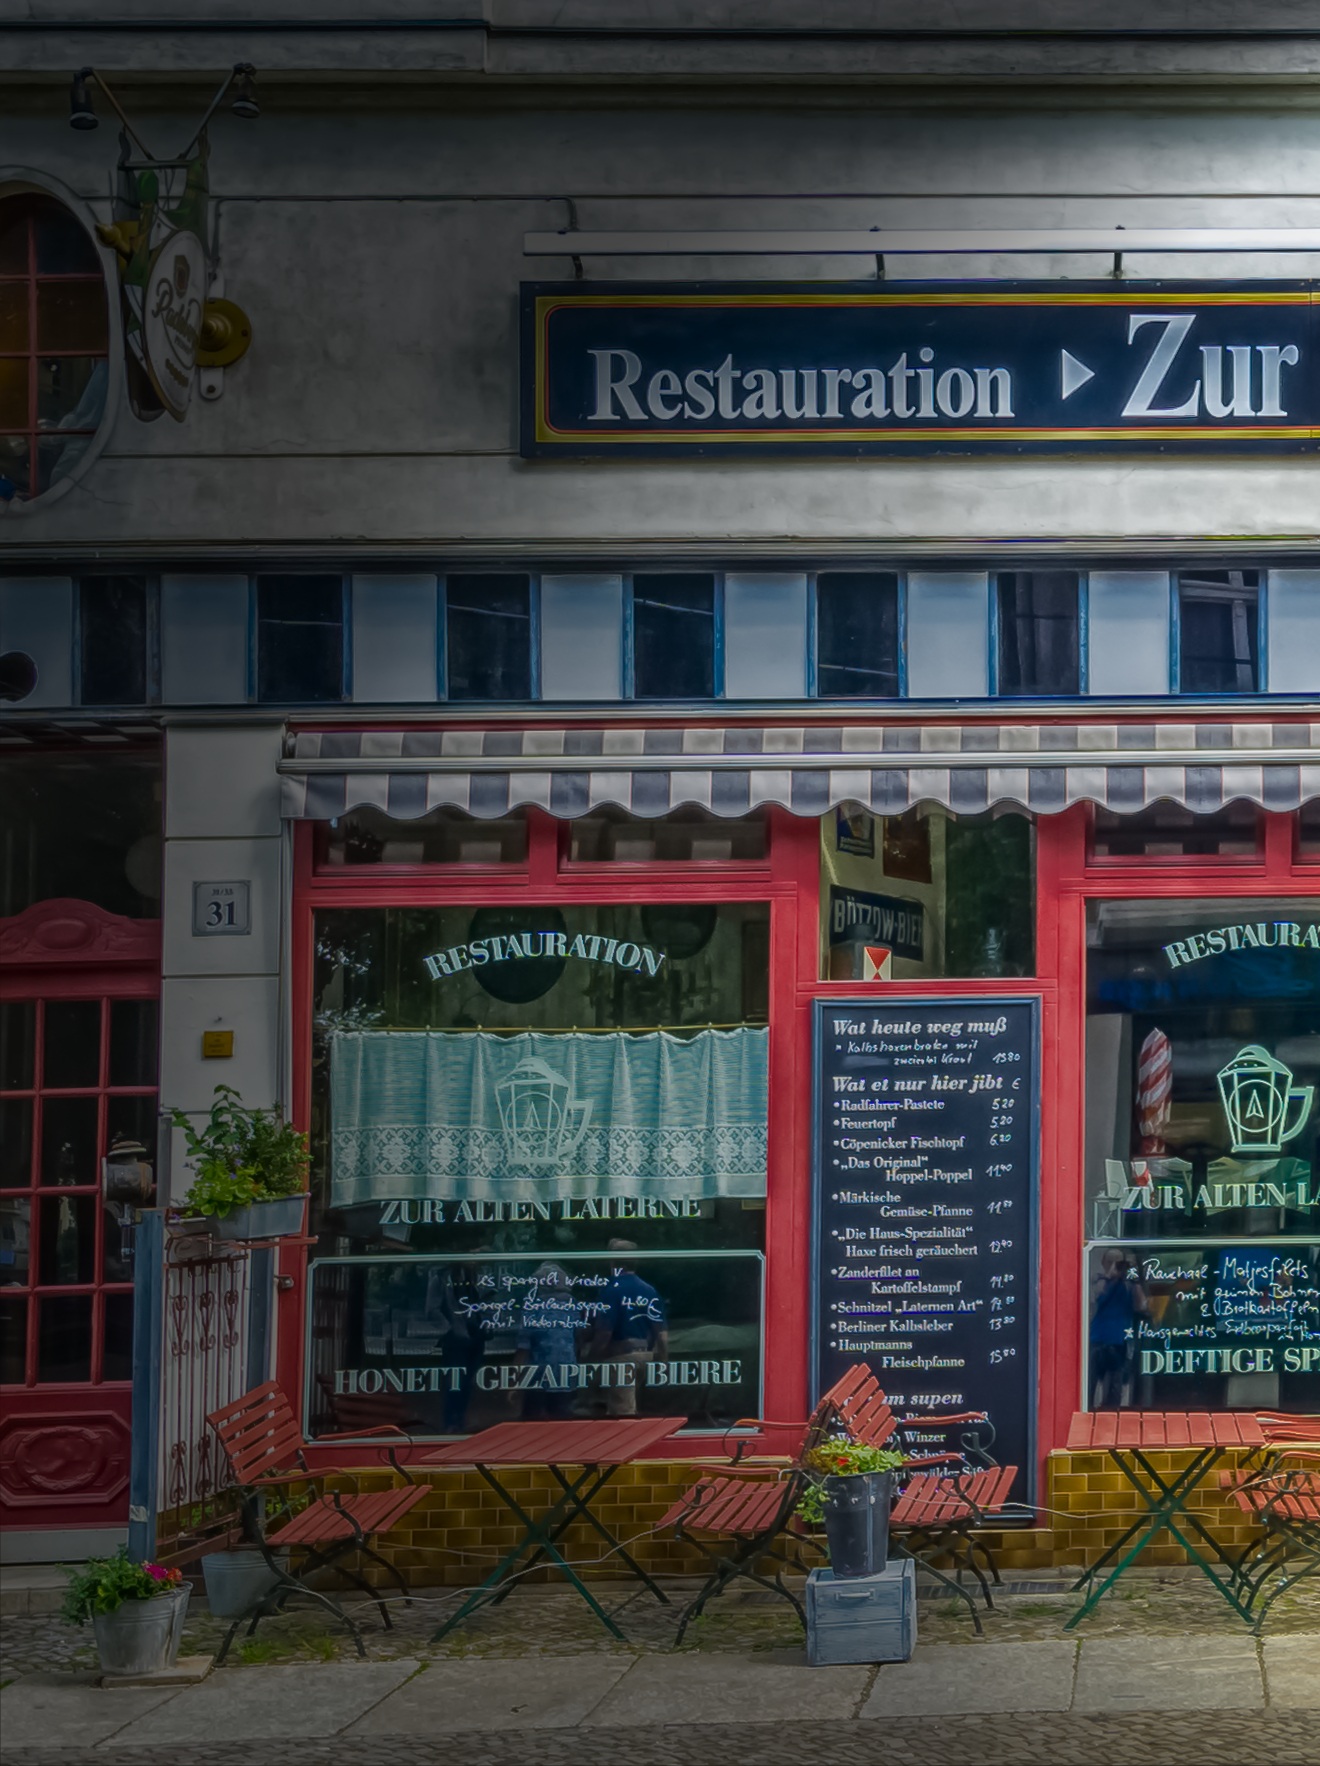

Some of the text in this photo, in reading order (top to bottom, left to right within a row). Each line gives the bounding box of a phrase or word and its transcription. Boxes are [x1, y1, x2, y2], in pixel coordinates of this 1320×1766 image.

[587, 347, 1015, 421] Restauration
[1119, 313, 1299, 418] Zur
[206, 901, 237, 926] 31
[423, 931, 665, 980] RESTAURATION
[832, 1016, 1007, 1037] Wat heute weg muß
[832, 1075, 1003, 1094] Wat et nur hier jibt
[840, 1099, 945, 1111] Radfahrer-Pastete
[840, 1117, 898, 1131] Feuertopf
[840, 1136, 966, 1151] Cöpenicker Fischtopf
[885, 1169, 973, 1184] Hoppel-Poppel
[840, 1191, 901, 1204] Märkische
[1120, 1184, 1185, 1212] ZUR
[1193, 1182, 1287, 1210] ALTEN
[380, 1196, 701, 1225] ZUR ALTEN LATERNE
[880, 1205, 973, 1219] Gemüse-Pfanne
[845, 1244, 978, 1259] Haxe frisch geräuchert
[837, 1266, 920, 1278] Zanderfilet an
[871, 1281, 962, 1295] Kartoffelstampf
[837, 1302, 892, 1313] Schnitzel
[838, 1320, 954, 1333] Berliner Kalbsleber
[838, 1339, 913, 1353] Hauptmanns
[882, 1356, 966, 1370] Fleischpfanne
[1141, 1347, 1274, 1375] DEFTIGE
[334, 1358, 742, 1395] HONETT GEZAPFTE BIERE
[910, 1392, 964, 1409] supen
[904, 1430, 947, 1443] Winzer
